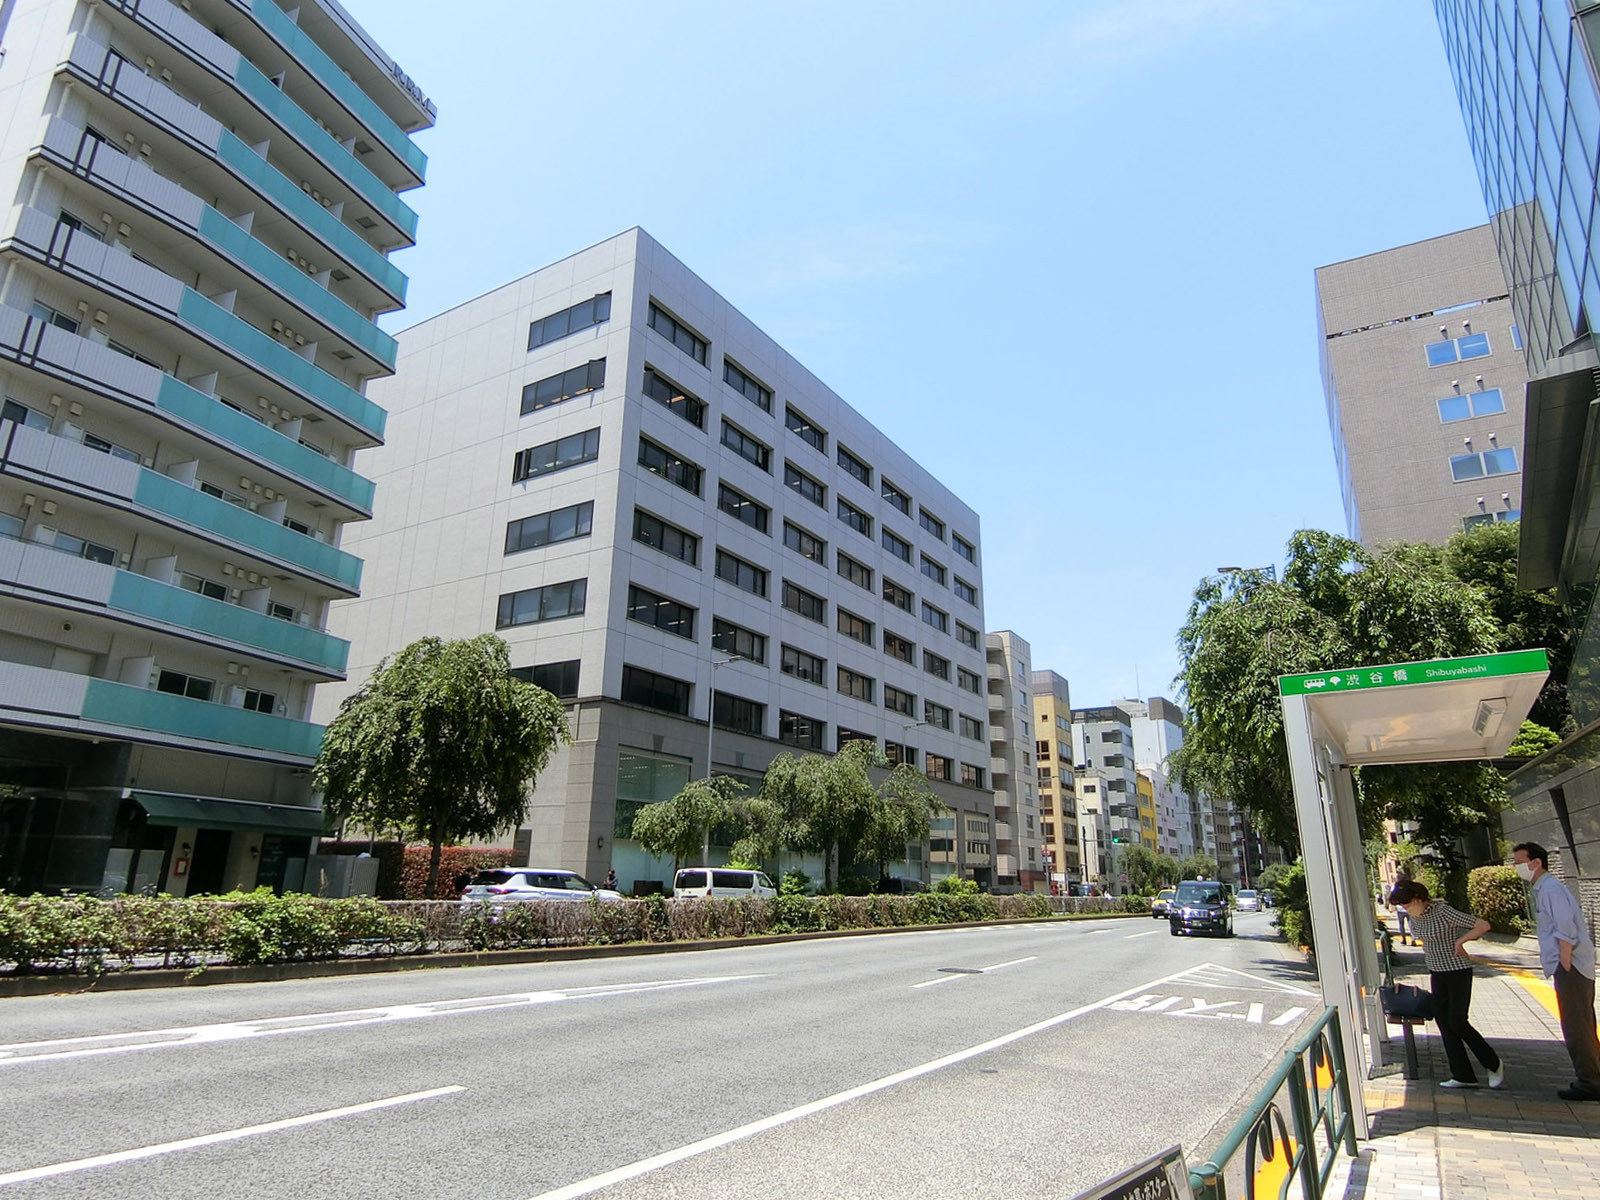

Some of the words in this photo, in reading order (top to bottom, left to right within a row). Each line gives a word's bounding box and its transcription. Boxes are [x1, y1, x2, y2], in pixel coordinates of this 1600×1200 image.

[1346, 669, 1408, 686] 渋谷橋
[1425, 664, 1487, 678] Shibuyabashi
